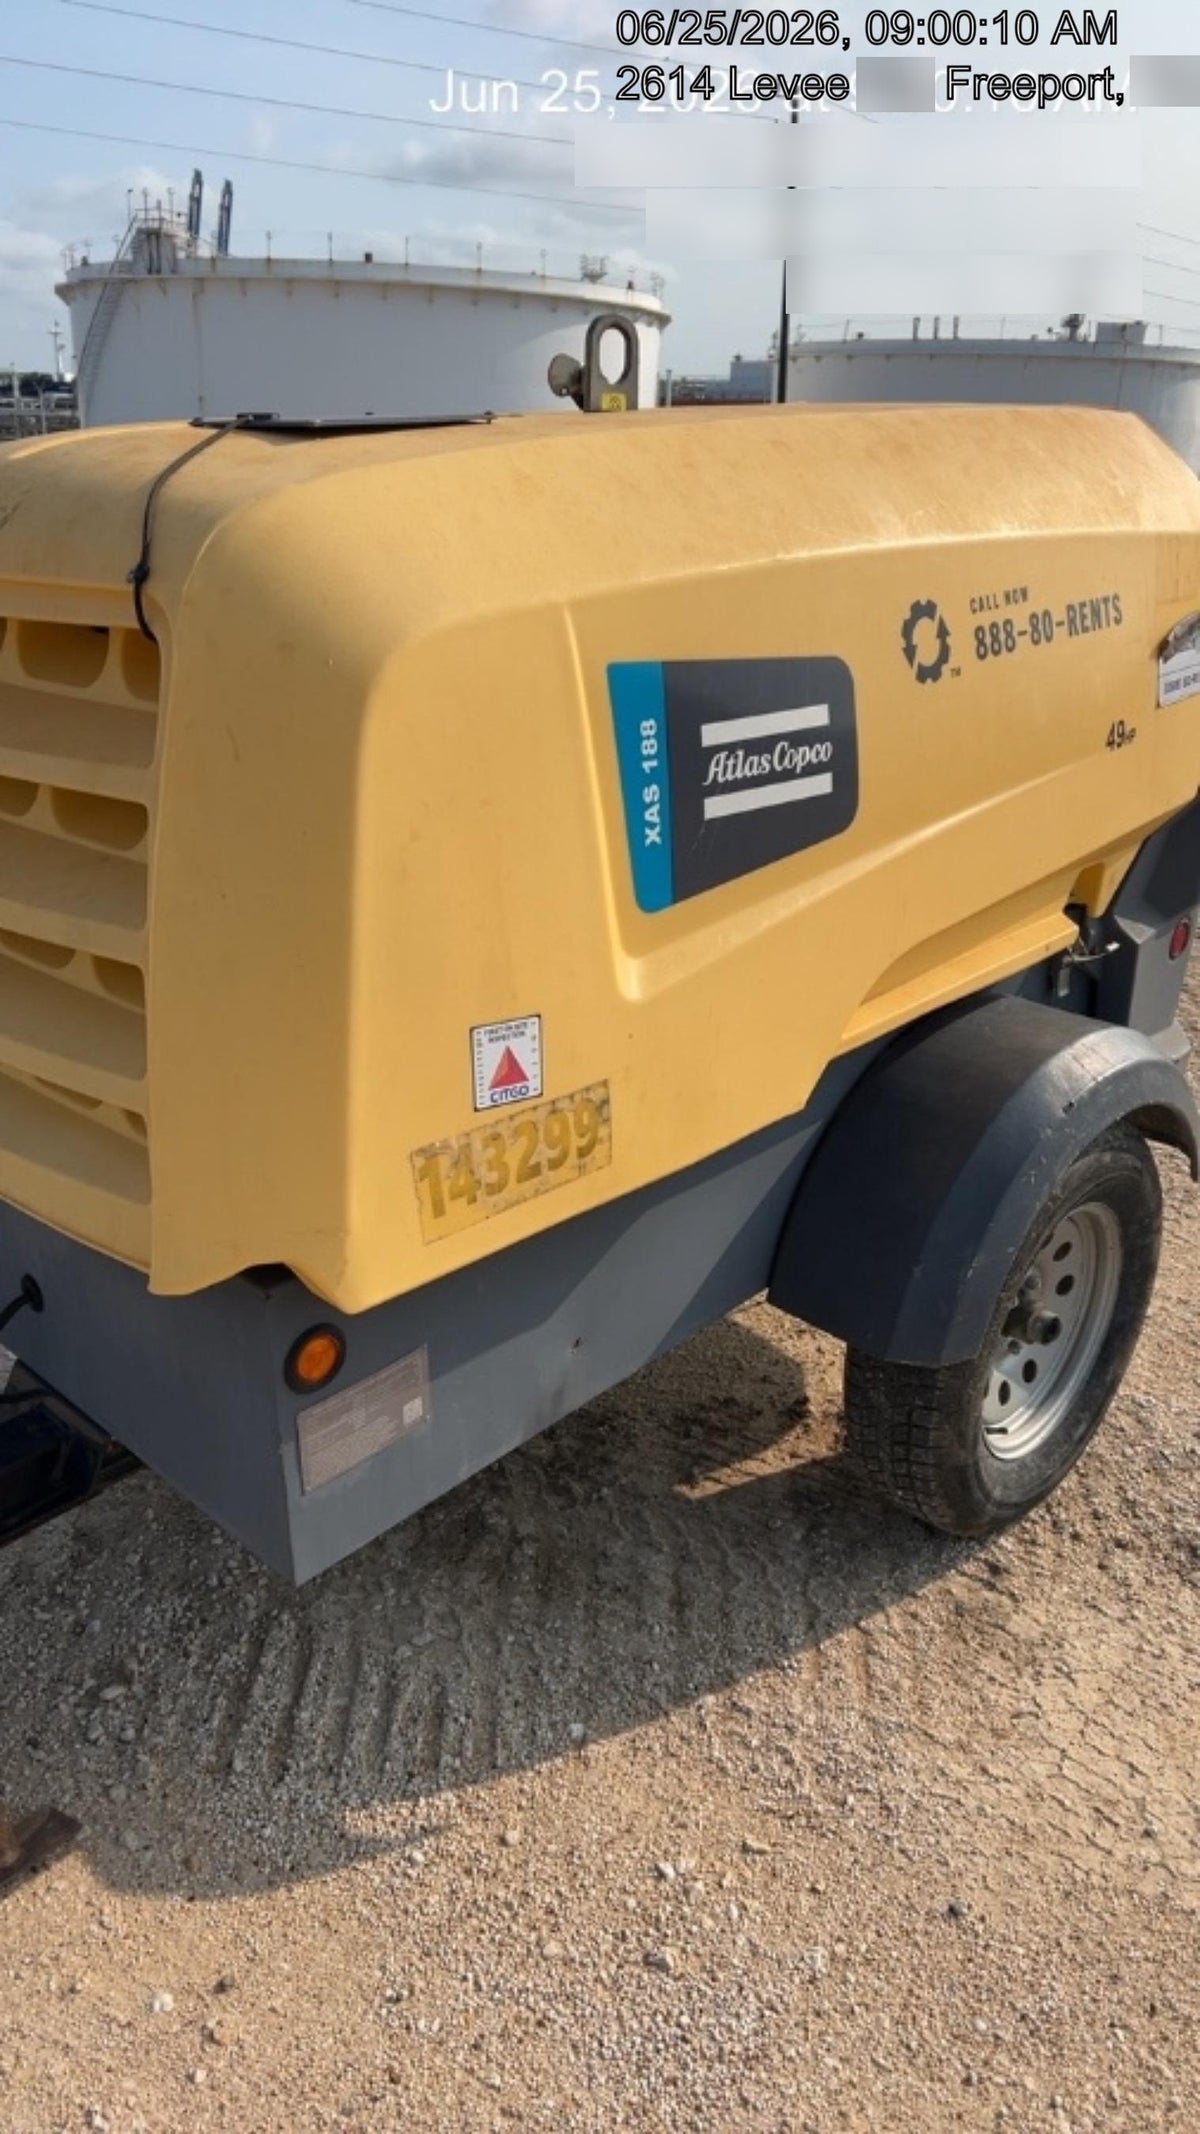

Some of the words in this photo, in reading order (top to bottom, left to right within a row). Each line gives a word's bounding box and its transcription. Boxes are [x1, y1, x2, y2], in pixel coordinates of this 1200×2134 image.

[970, 593, 999, 614] CALL
[1003, 586, 1028, 606] NOW
[974, 592, 1123, 661] 888-80-RENTS
[640, 718, 658, 774] 188
[702, 749, 771, 785] Atlas
[773, 741, 833, 774] Copco
[643, 783, 662, 848] XAS
[490, 1085, 529, 1103] CITGO
[418, 1097, 600, 1220] 143299
